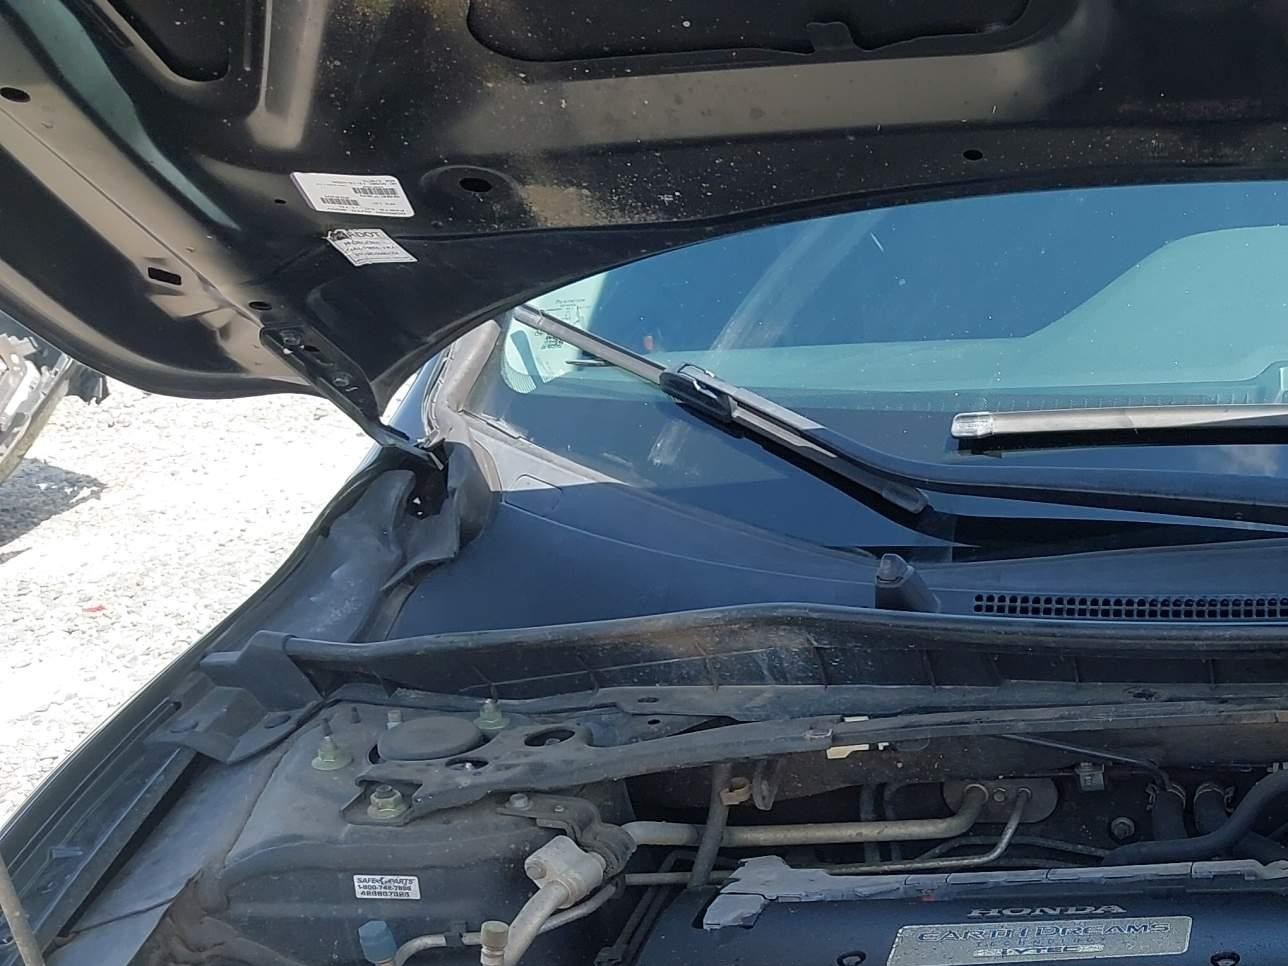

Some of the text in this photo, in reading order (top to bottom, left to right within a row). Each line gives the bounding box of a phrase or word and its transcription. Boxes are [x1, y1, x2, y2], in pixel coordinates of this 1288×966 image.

[968, 905, 1127, 917] HONDA
[918, 922, 1171, 943] EARTH DREAMS
